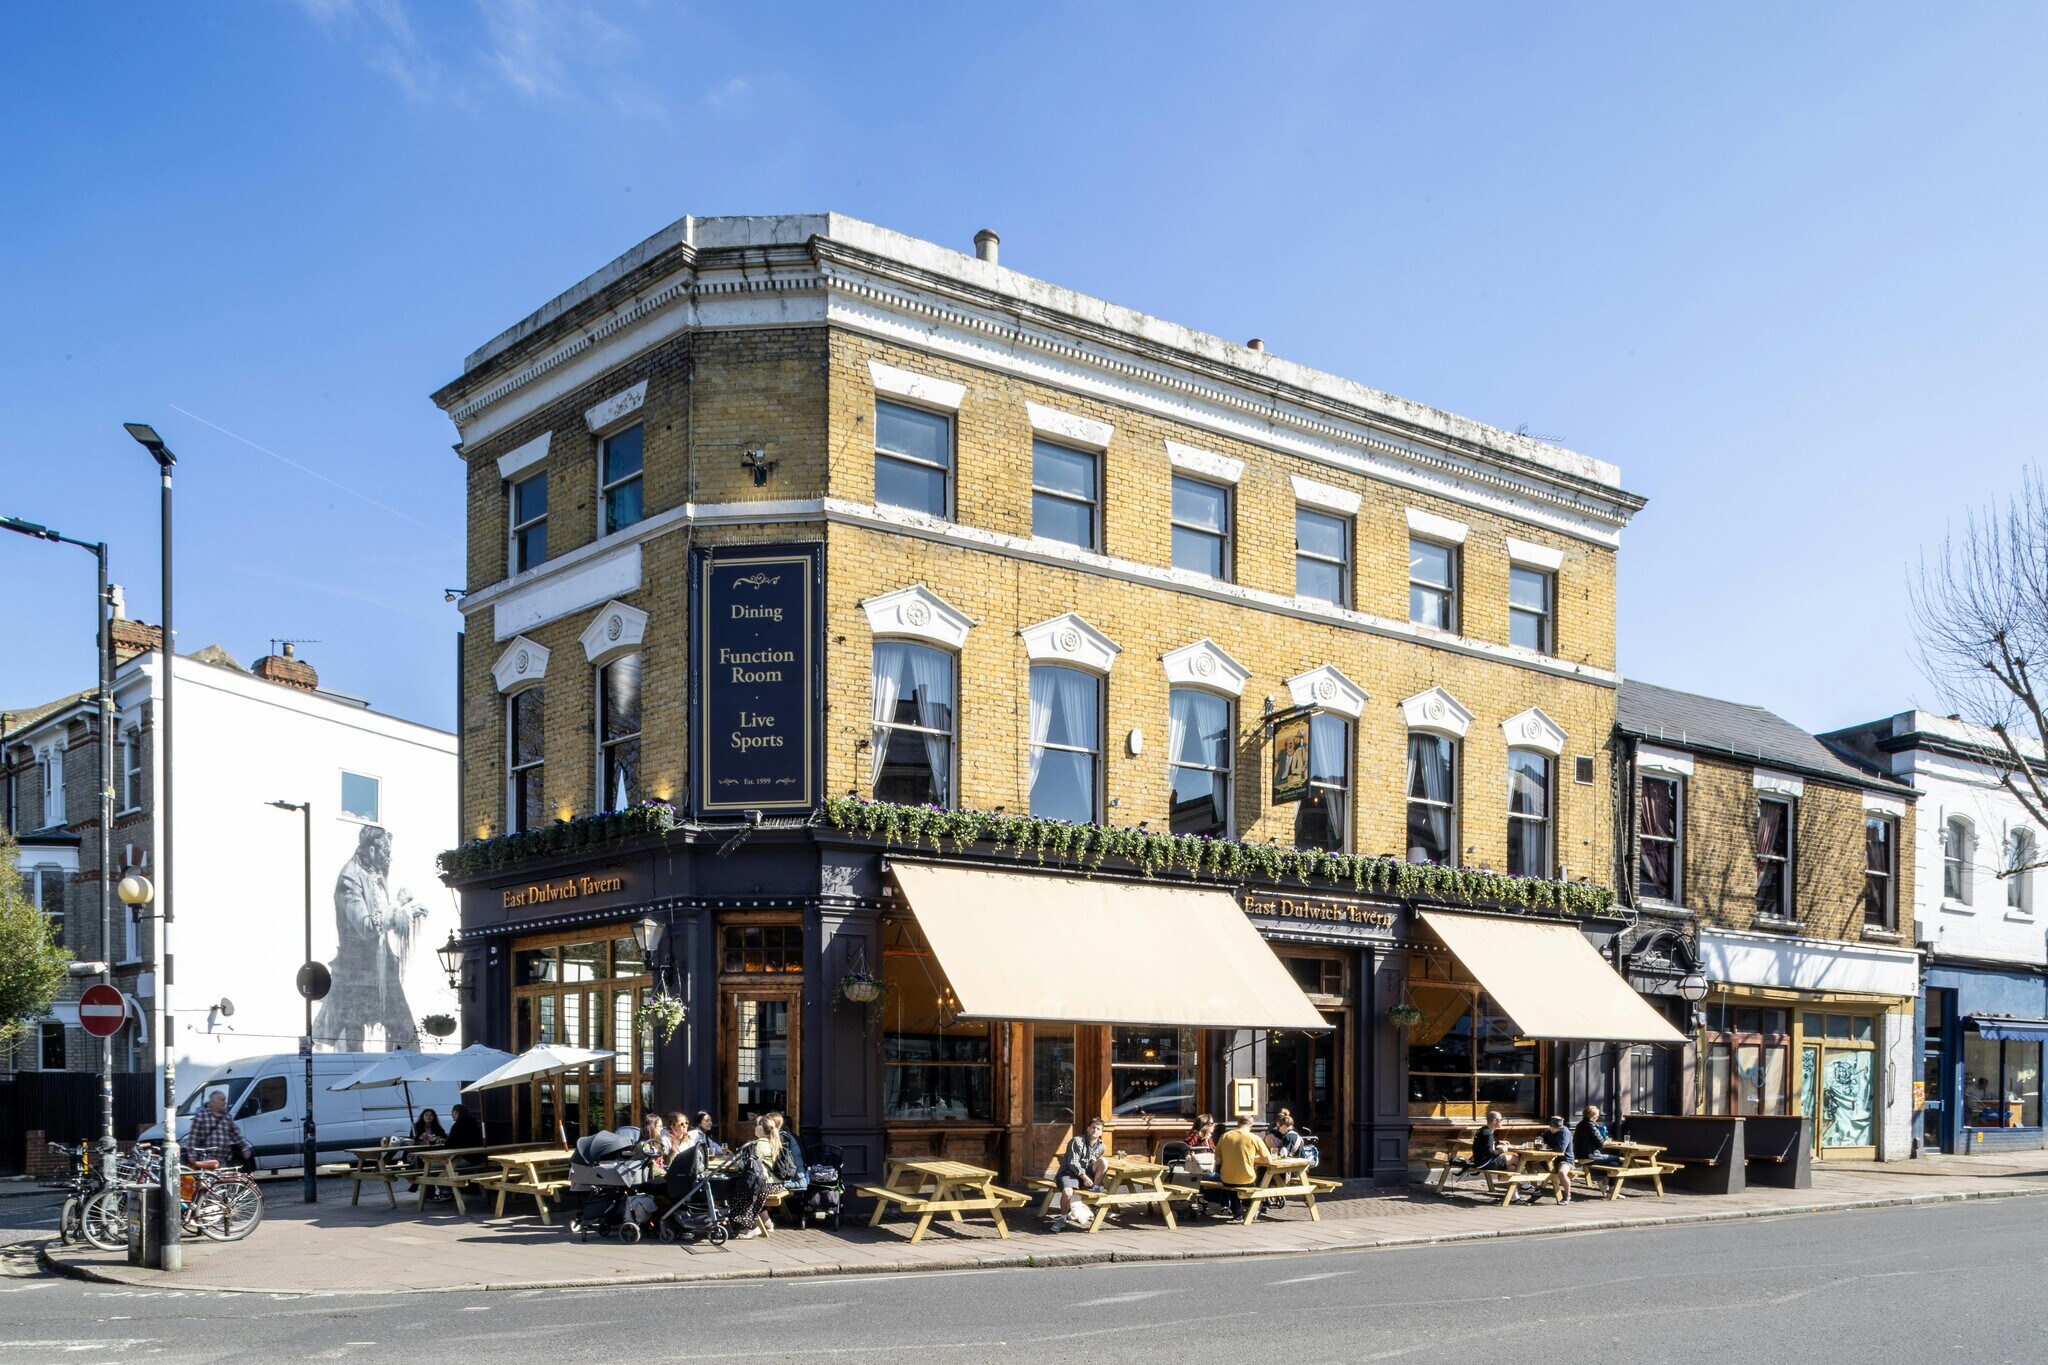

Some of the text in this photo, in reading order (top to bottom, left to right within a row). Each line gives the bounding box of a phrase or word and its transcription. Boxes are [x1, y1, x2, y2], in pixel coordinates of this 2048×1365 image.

[731, 605, 783, 621] Dining
[719, 648, 795, 665] Function
[731, 667, 783, 683] Room
[739, 712, 775, 728] Live
[731, 732, 783, 753] Sports
[757, 777, 771, 785] 1999
[503, 877, 621, 908] East Dulwich Tavern
[1244, 896, 1392, 926] East Dulwich Tavern
